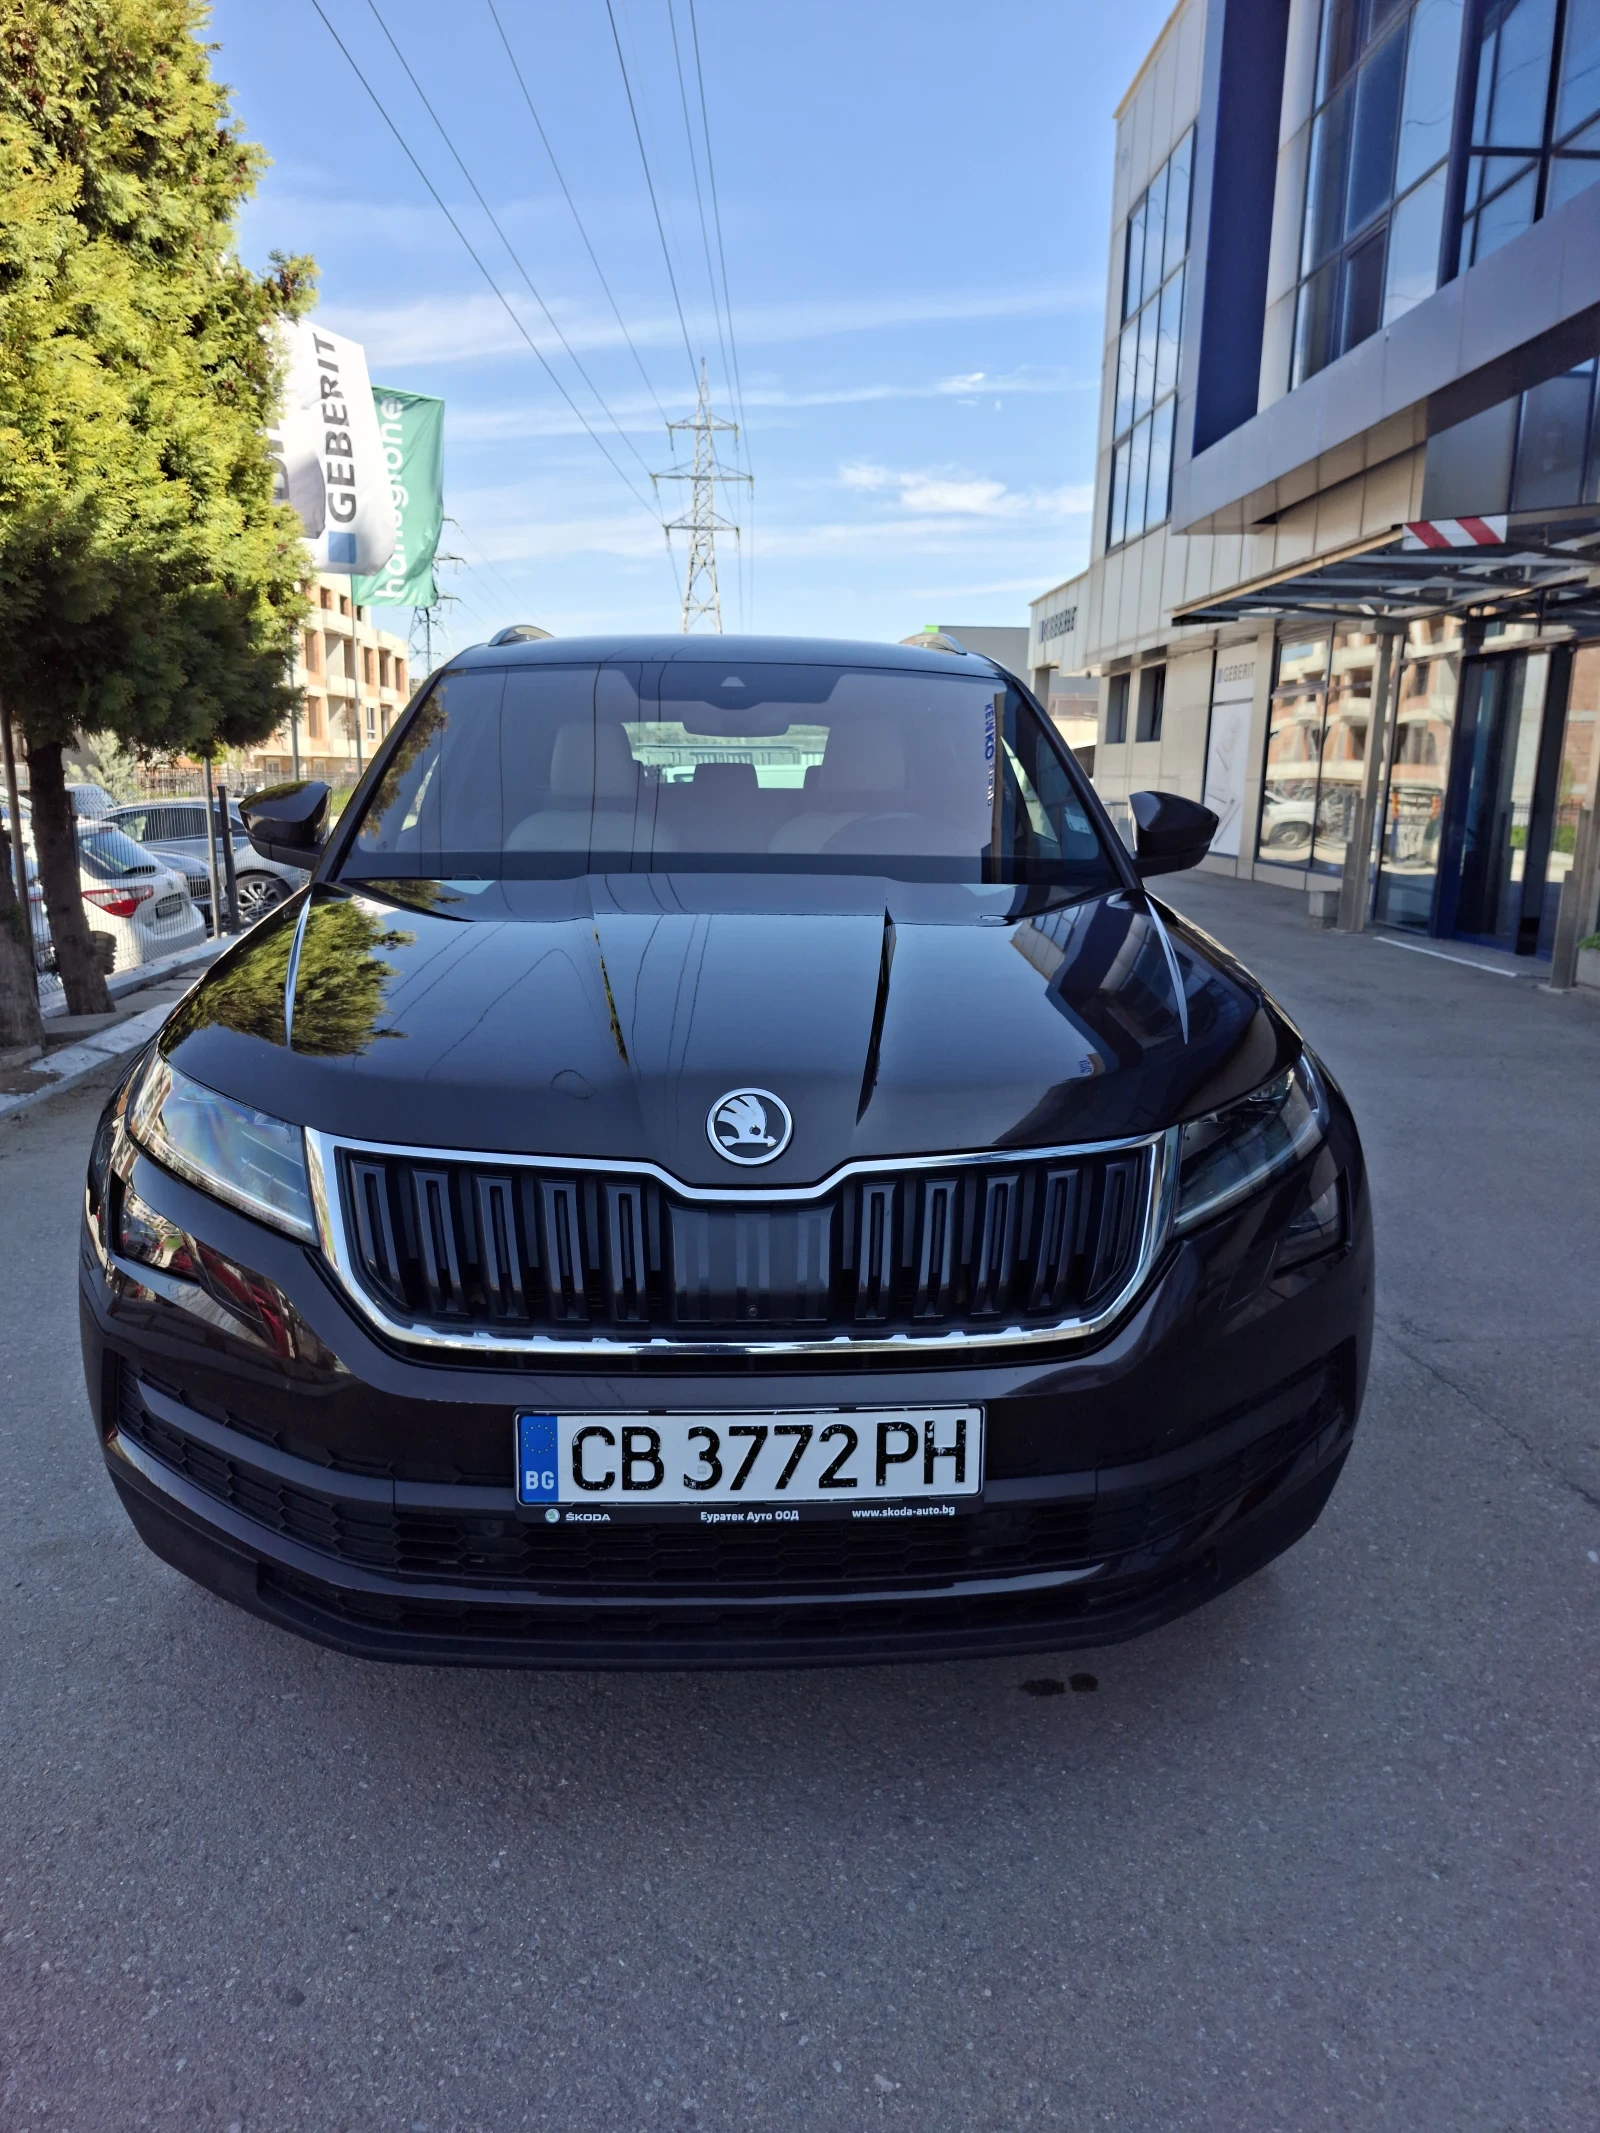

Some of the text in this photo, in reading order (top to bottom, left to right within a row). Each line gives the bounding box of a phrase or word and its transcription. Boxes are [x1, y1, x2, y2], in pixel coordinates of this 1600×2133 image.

[312, 332, 357, 524] GEBERIT
[1223, 662, 1255, 682] GEBERIT
[572, 1419, 966, 1490] CB 3772 PH
[525, 1470, 554, 1490] BG
[565, 1507, 611, 1521] ŠKODA
[700, 1510, 799, 1523] Еуратек Ауто ООД
[852, 1505, 956, 1518] www.skoda-auto.bg
